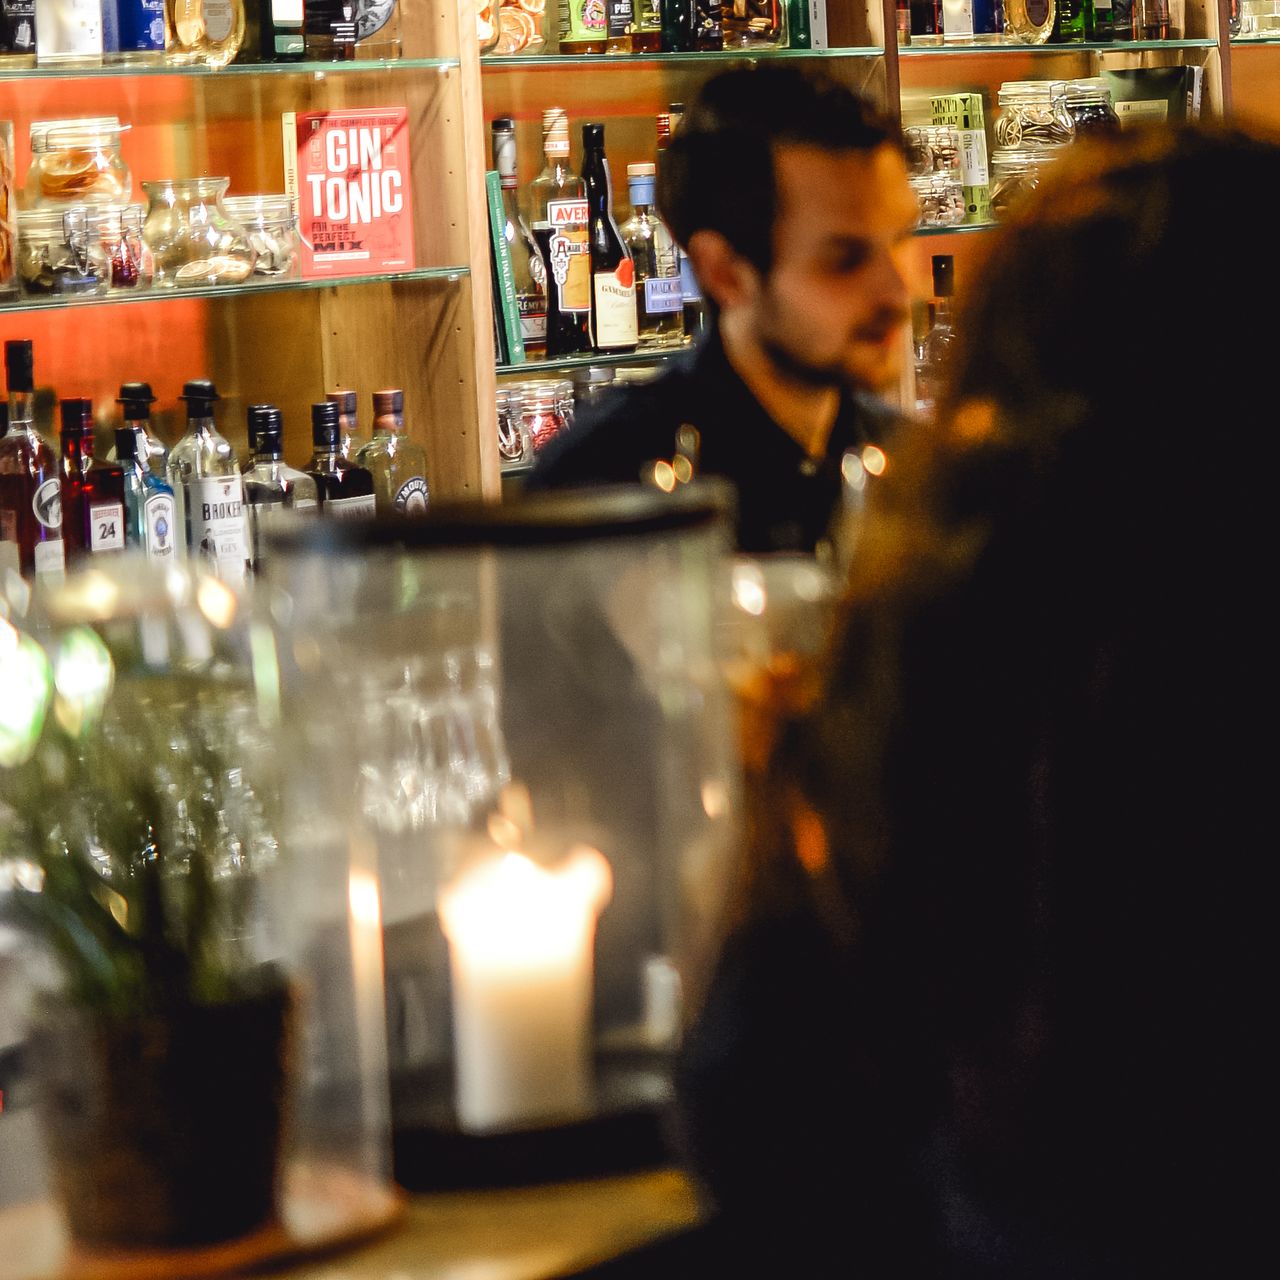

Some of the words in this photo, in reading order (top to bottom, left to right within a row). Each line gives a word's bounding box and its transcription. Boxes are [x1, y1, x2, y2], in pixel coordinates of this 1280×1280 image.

[326, 128, 382, 173] GIN
[306, 170, 404, 224] TONIC
[556, 207, 589, 221] AVER
[312, 231, 356, 242] PERFECT
[313, 241, 364, 252] MIX
[202, 500, 242, 521] BROKER
[99, 523, 116, 539] 24
